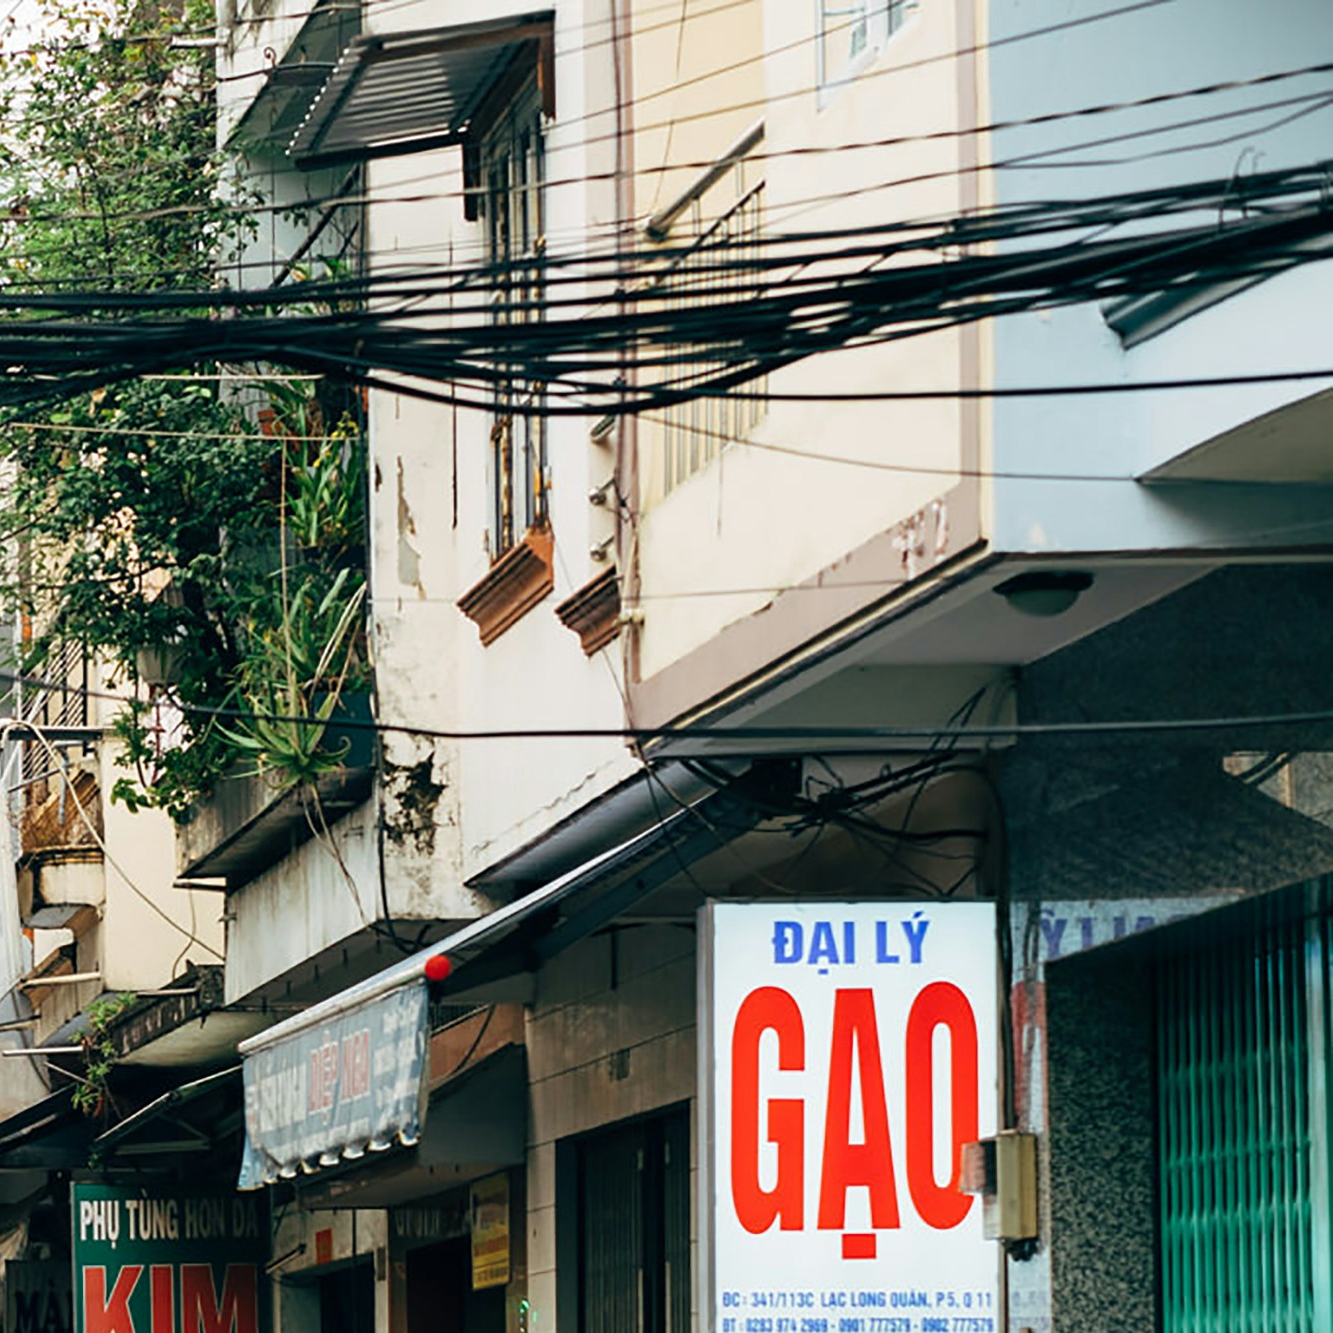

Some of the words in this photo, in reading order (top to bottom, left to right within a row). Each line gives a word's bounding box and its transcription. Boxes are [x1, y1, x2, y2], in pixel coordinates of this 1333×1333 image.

[771, 919, 856, 976] ĐẠI
[876, 910, 931, 965] LÝ
[731, 981, 979, 1260] GẠO
[80, 1199, 120, 1249] PHỤ
[126, 1188, 178, 1241] TÙNG
[820, 1291, 846, 1310] LẠC
[850, 1291, 887, 1308] LONG
